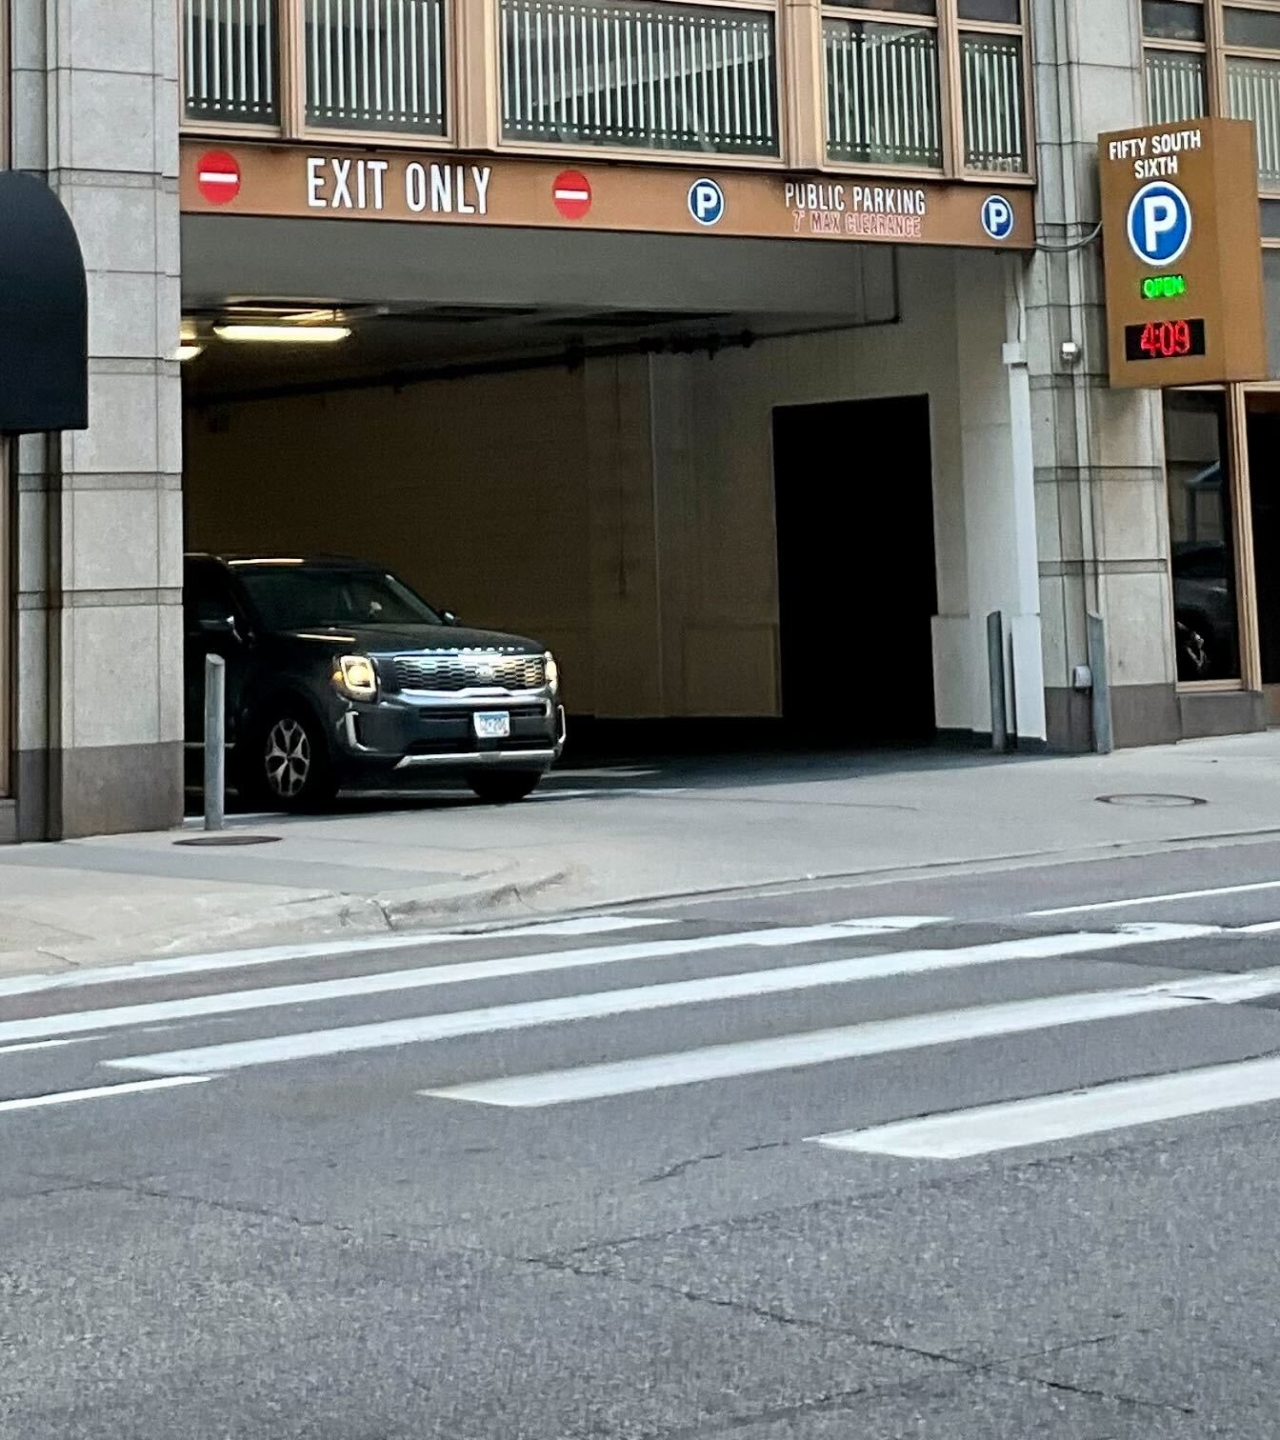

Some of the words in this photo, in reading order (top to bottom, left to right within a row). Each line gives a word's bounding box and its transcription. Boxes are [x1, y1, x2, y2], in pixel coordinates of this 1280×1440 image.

[1109, 136, 1147, 161] FIFTY
[1151, 129, 1201, 154] SOUTH
[1134, 155, 1179, 179] SIXTH
[307, 157, 389, 210] EXIT
[405, 162, 491, 215] ONLY
[696, 186, 718, 218] P
[785, 182, 845, 211] PUBLIC
[852, 186, 926, 215] PARKING
[810, 211, 841, 234] MAX
[845, 212, 922, 237] CLEARANCE
[988, 202, 1008, 232] P
[1143, 195, 1178, 252] P
[1143, 275, 1185, 298] OPEN
[1140, 320, 1190, 357] 4:09
